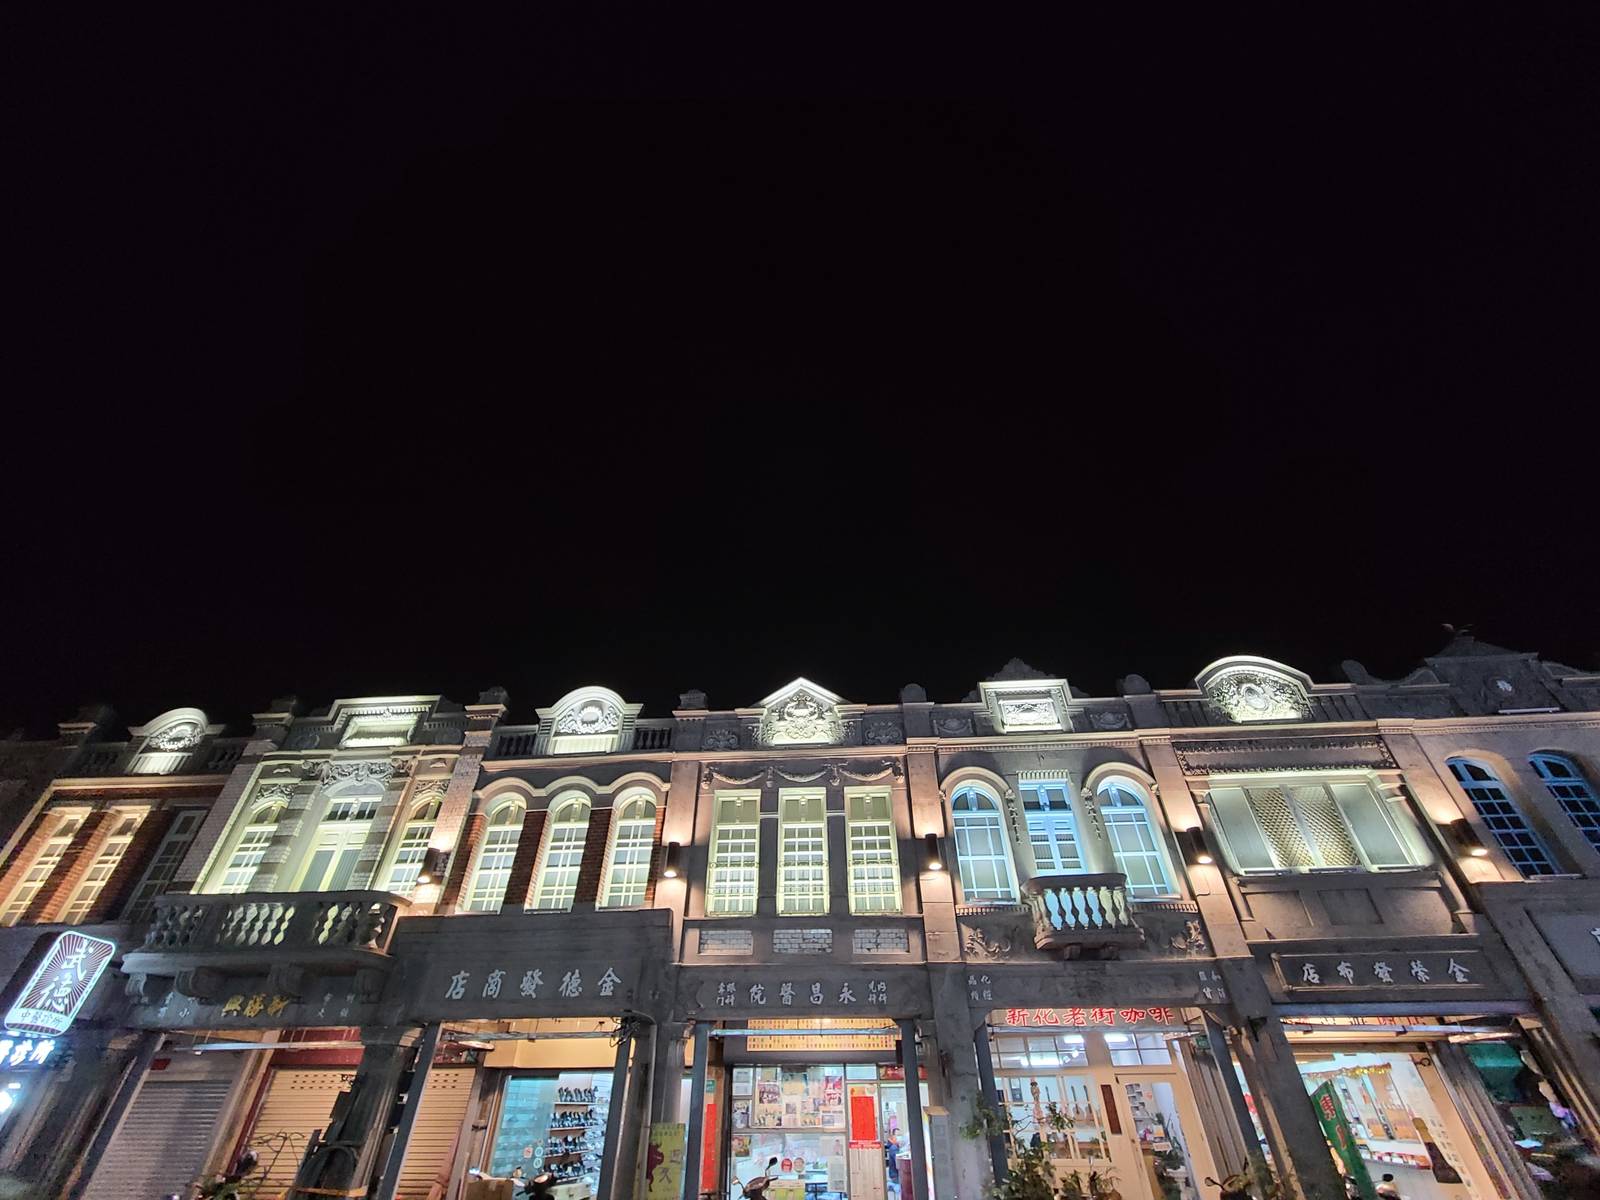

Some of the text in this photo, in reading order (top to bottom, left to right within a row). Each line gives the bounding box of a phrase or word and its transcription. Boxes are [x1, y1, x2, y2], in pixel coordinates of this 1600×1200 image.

[750, 982, 857, 1006] 永昌醫院
[1006, 1008, 1174, 1026] 新化老街咖啡
